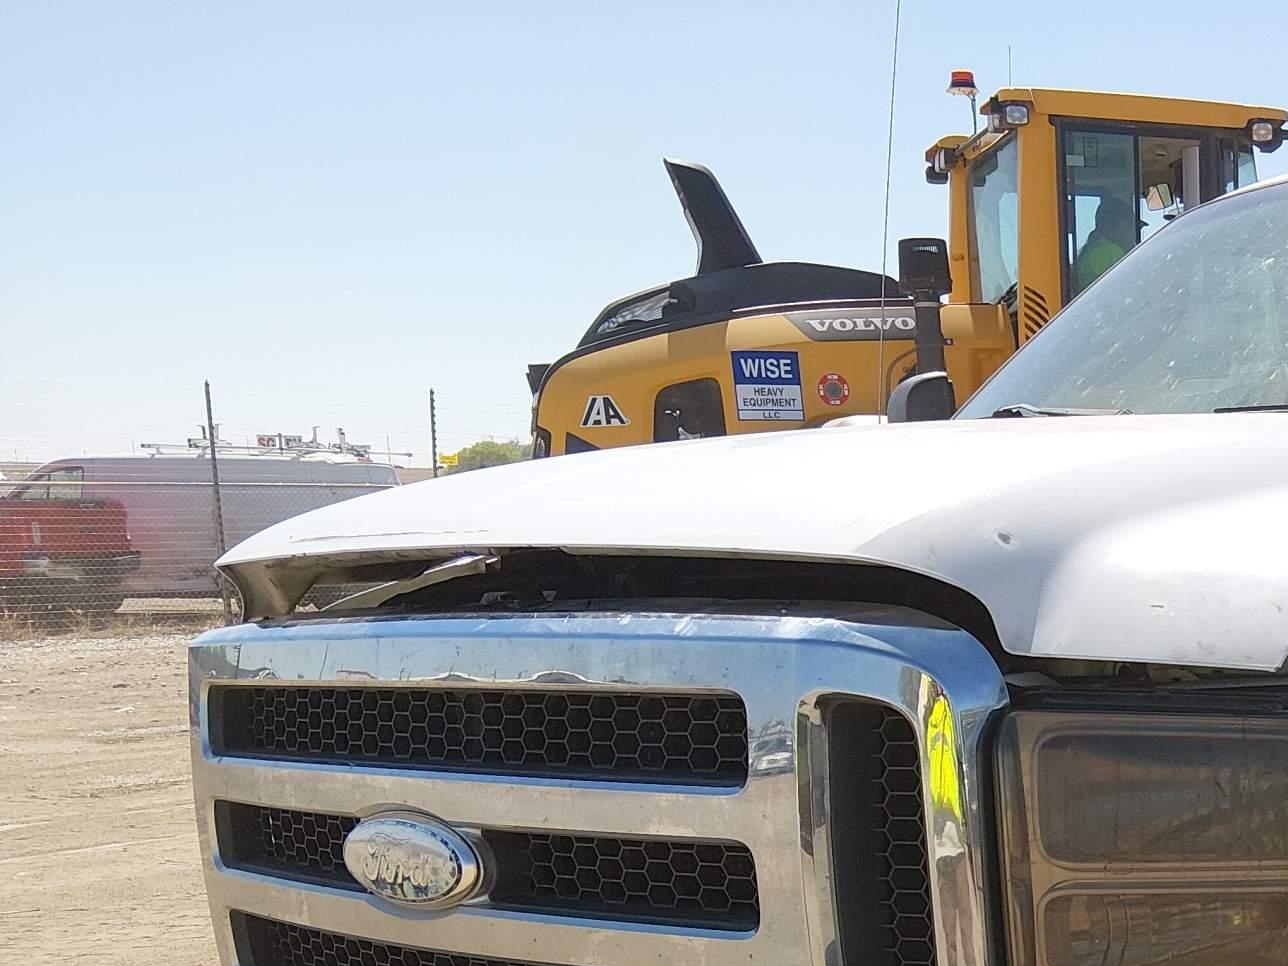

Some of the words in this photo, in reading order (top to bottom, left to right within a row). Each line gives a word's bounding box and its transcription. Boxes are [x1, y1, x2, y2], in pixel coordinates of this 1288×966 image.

[805, 317, 916, 332] VOLVO
[739, 358, 793, 379] WISE
[753, 387, 784, 397] HEAVY
[742, 398, 797, 408] EQUIPMENT
[762, 411, 781, 419] LLC
[361, 832, 433, 888] Ford
